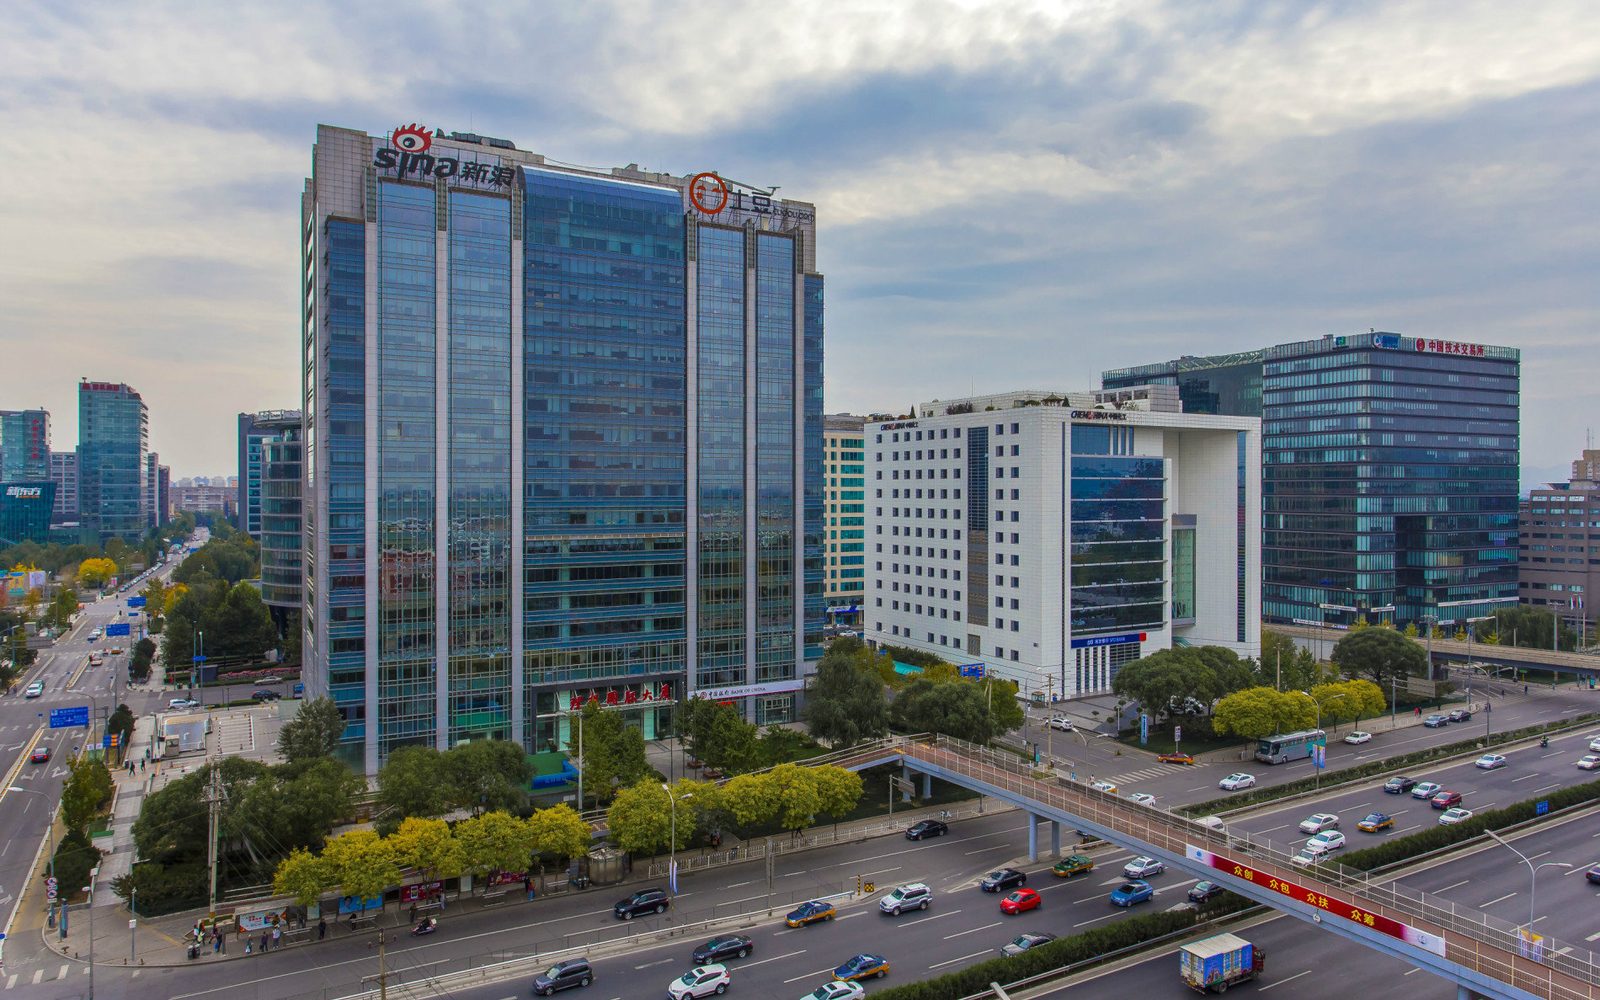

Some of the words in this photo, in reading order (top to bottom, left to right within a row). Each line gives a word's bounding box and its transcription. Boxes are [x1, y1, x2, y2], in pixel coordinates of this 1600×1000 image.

[374, 147, 459, 181] sina
[461, 161, 516, 187] 新浪
[727, 188, 773, 215] 土豆
[1428, 339, 1485, 357] 中国技术交易所
[1233, 865, 1254, 881] 众创
[1269, 878, 1291, 894] 众包
[1306, 892, 1329, 909] 众扶
[1351, 909, 1375, 926] 众筹
